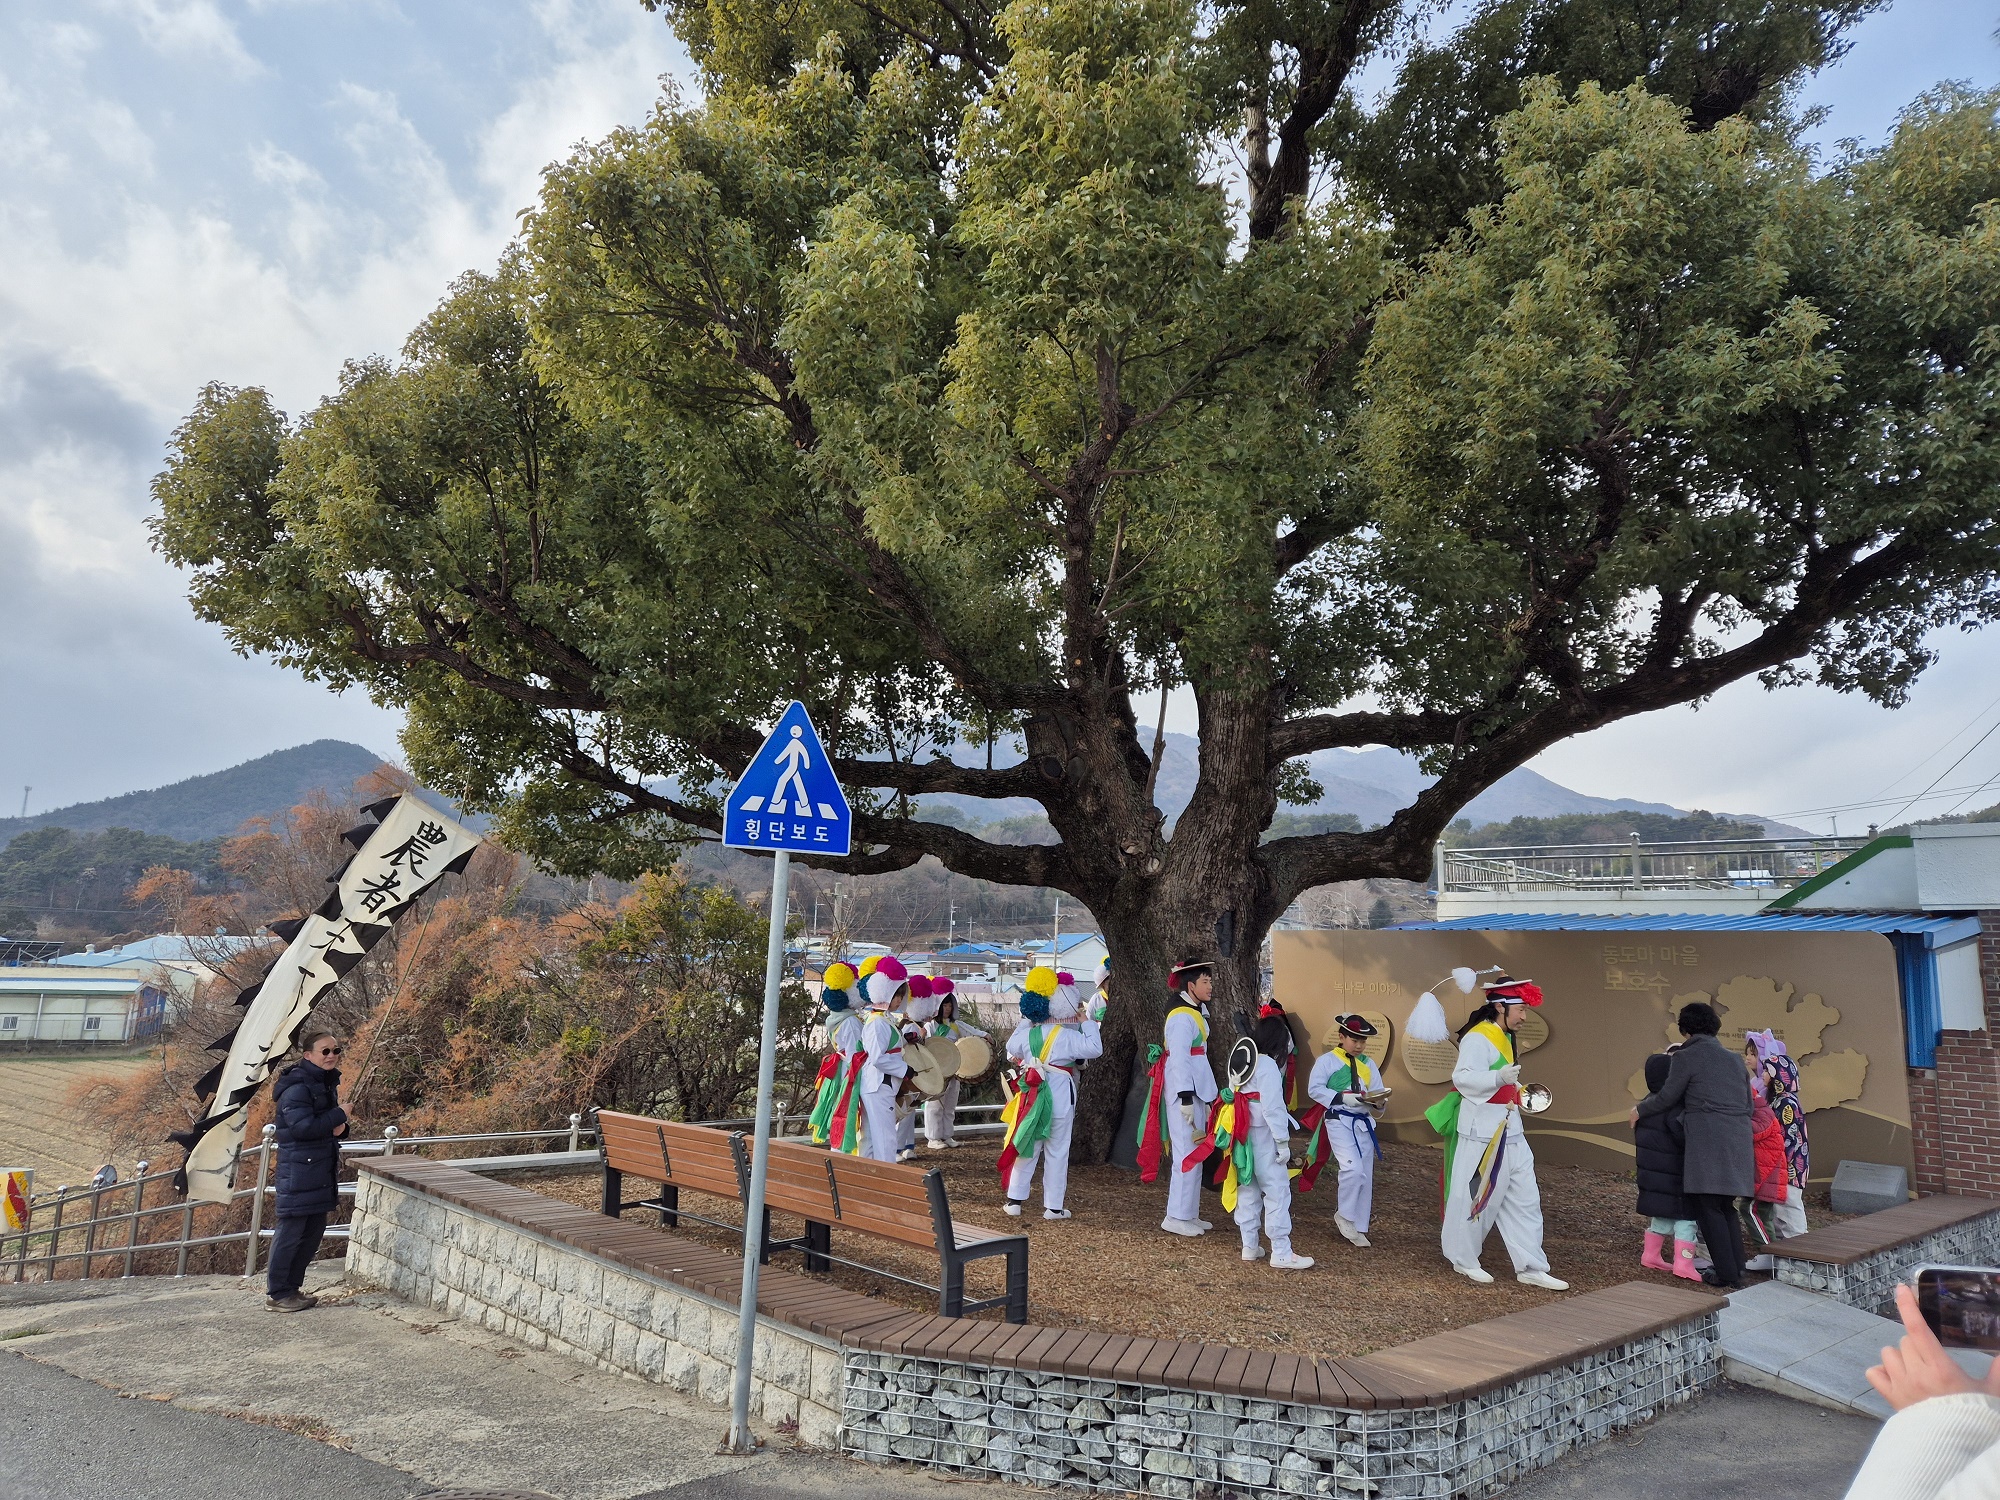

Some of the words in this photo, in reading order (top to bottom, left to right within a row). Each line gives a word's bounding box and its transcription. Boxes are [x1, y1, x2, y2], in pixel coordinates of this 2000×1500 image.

[744, 818, 830, 843] 횡단보도
[1602, 945, 1656, 966] 동도마
[1660, 944, 1700, 967] 마을
[1333, 981, 1366, 995] 녹나무
[1369, 982, 1403, 996] 이야기
[1603, 969, 1672, 995] 보호수
